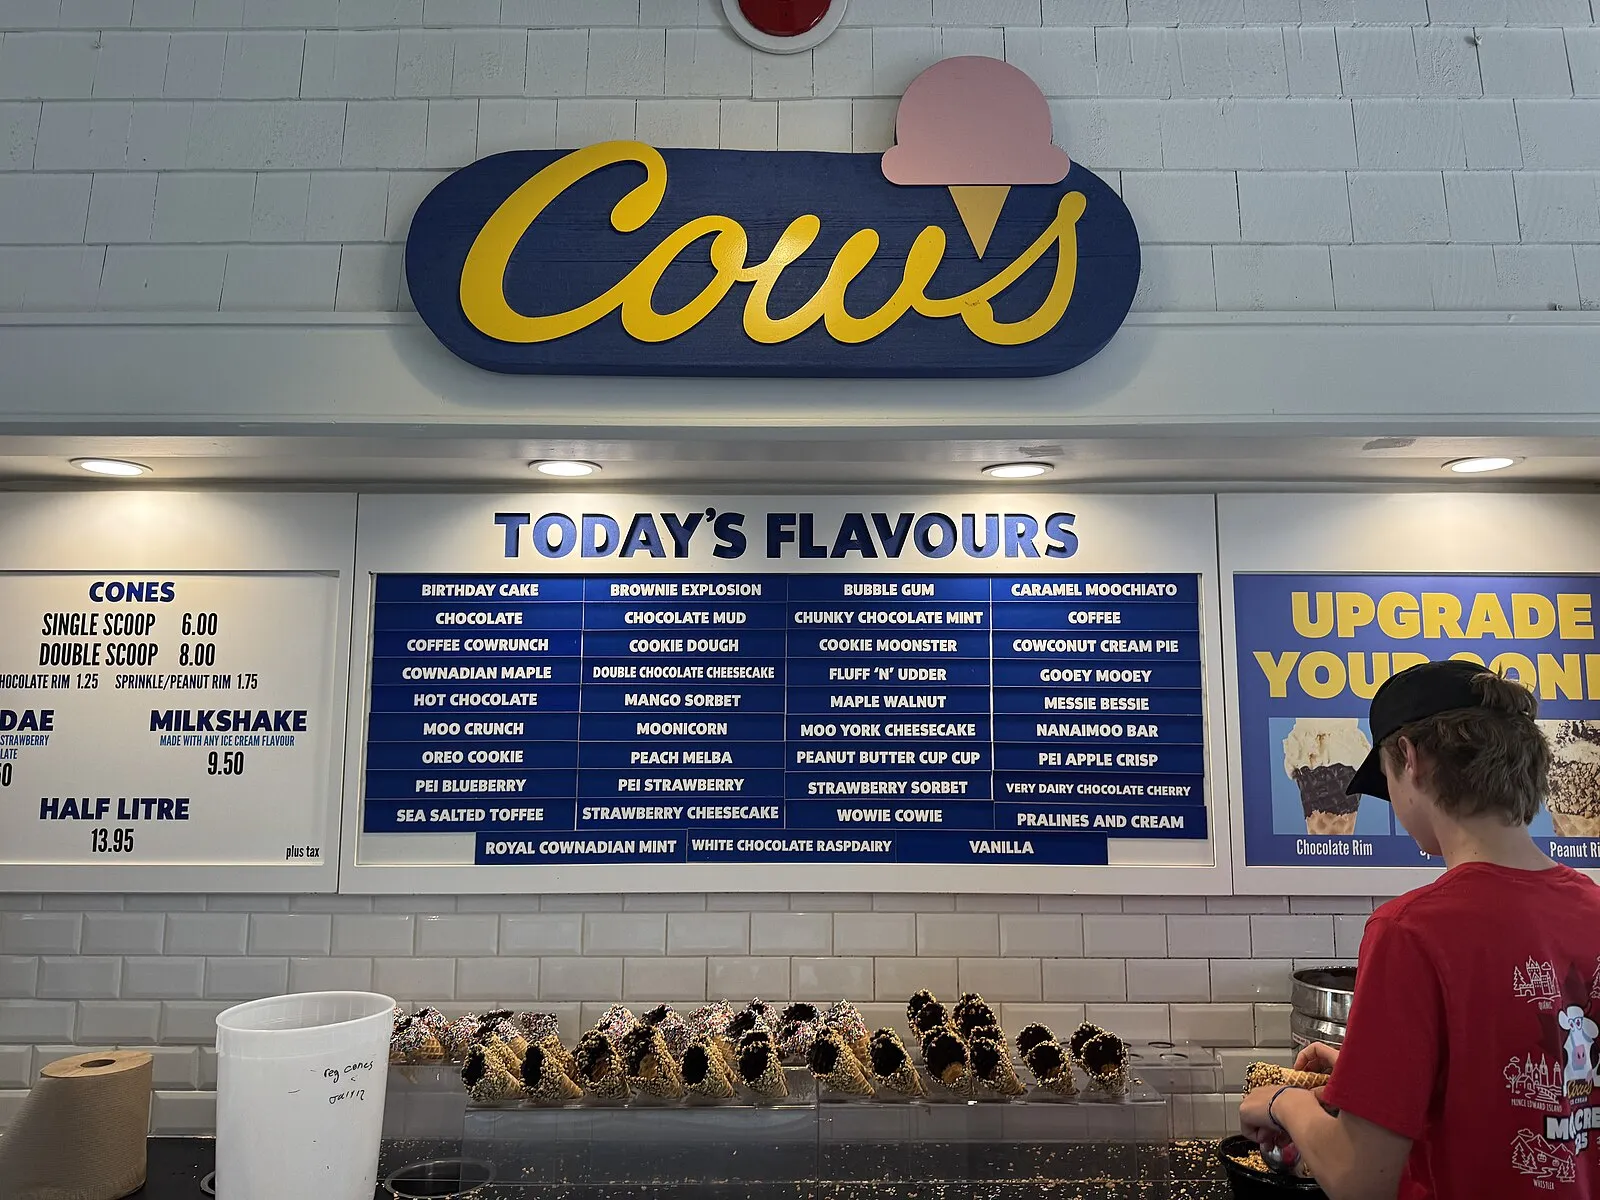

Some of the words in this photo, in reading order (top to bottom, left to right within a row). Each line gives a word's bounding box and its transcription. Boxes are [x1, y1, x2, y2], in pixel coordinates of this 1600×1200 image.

[494, 507, 746, 558] TODAY'S
[766, 511, 1078, 558] FLAVOURS
[89, 581, 175, 602] CONES
[421, 583, 497, 597] BIRTHDAY
[498, 583, 539, 597] CAKE
[610, 583, 679, 597] BROWNIE
[681, 583, 762, 596] EXPLOSION
[843, 583, 898, 596] BUBBLE
[901, 583, 935, 597] GUM
[1010, 583, 1083, 597] CARAMEL
[1085, 583, 1178, 597] MOOCHIATO
[435, 611, 523, 625] CHOCOLATE
[624, 611, 710, 625] CHOCOLATE
[712, 611, 747, 624] MUD
[794, 611, 855, 624] CHUNKY
[857, 611, 943, 624] CHOCOLATE
[946, 611, 984, 625] MINT
[1067, 611, 1122, 625] COFFEE
[1291, 591, 1595, 640] UPGRADE
[41, 612, 99, 636] SINGLE
[102, 612, 156, 636] SCOOP
[181, 612, 218, 636] 6.00
[406, 638, 461, 652] COFFEE
[463, 638, 549, 652] COWRUNCH
[628, 638, 684, 653] COOKIE
[686, 638, 739, 653] DOUGH
[818, 638, 873, 652] COOKIE
[876, 638, 958, 652] MOONSTER
[1012, 638, 1097, 653] COWCONUT
[1100, 639, 1153, 653] CREAM
[1155, 639, 1179, 653] PIE
[38, 643, 101, 666] DOUBLE
[105, 643, 159, 666] SCOOP
[179, 643, 216, 667] 8.00
[402, 666, 498, 680] COWNADIAN
[500, 666, 552, 680] MAPLE
[592, 666, 637, 679] DOUBLE
[638, 666, 704, 679] CHOCOLATE
[706, 666, 775, 679] CHEESECAKE
[829, 667, 871, 681] FLUFF
[897, 667, 947, 681] UDDER
[1039, 668, 1093, 682] GOOEY
[1095, 669, 1153, 683] MOOEY
[1252, 651, 1430, 700] YOU
[51, 673, 70, 690] RIM
[76, 673, 99, 690] 1.25
[115, 673, 211, 691] SPRINKLE/PEANUT
[212, 673, 231, 690] RIM
[237, 673, 258, 690] 1.75
[413, 693, 447, 707] HOT
[449, 693, 538, 706] CHOCOLATE
[624, 693, 682, 707] MANGO
[684, 693, 742, 707] SORBET
[830, 695, 880, 708] MAPLE
[883, 695, 947, 709] WALNUT
[1044, 696, 1097, 710] MESSIE
[1100, 697, 1150, 711] BESSIE
[149, 709, 308, 732] MILKSHAKE
[423, 722, 461, 736] MOO
[464, 722, 524, 736] CRUNCH
[636, 722, 728, 736] MOONICORN
[800, 723, 837, 737] MOO
[839, 723, 881, 737] YORK
[884, 723, 976, 737] CHEESECAKE
[1036, 723, 1124, 738] NANAIMOO
[1126, 724, 1159, 738] BAR
[0, 735, 49, 746] STRAWBERRY
[160, 734, 181, 747] MADE
[183, 734, 202, 747] WITH
[204, 734, 219, 747] ANY
[221, 734, 233, 747] ICE
[234, 734, 260, 747] CREAM
[262, 734, 295, 747] FLAVOUR
[207, 751, 245, 776] 9.50
[421, 750, 464, 764] OREO
[467, 750, 524, 764] COOKIE
[630, 751, 679, 765] PEACH
[682, 751, 733, 764] MELBA
[796, 750, 856, 764] PEANUT
[859, 750, 916, 764] BUTTER
[918, 751, 948, 765] CUP
[951, 751, 981, 765] CUP
[1038, 752, 1062, 766] PEI
[1064, 752, 1113, 767] APPLE
[1115, 753, 1159, 767] CRISP
[415, 779, 439, 793] PEI
[441, 778, 527, 793] BLUEBERRY
[618, 778, 641, 792] PEI
[643, 778, 745, 792] STRAWBERRY
[807, 781, 908, 795] STRAWBERRY
[910, 780, 969, 795] SORBET
[1005, 782, 1037, 794] VERY
[1038, 783, 1075, 794] DAIRY
[1076, 783, 1145, 796] CHOCOLATE
[1146, 785, 1192, 797] CHERRY
[39, 797, 110, 820] HALF
[116, 797, 190, 820] LITRE
[396, 809, 427, 823] SEA
[429, 808, 486, 822] SALTED
[489, 807, 544, 822] TOFFEE
[582, 806, 684, 820] STRAWBERRY
[686, 806, 779, 820] CHEESECAKE
[836, 808, 891, 822] WOWIE
[894, 809, 943, 823] COWIE
[1016, 812, 1090, 828] PRALINES
[1092, 814, 1127, 828] AND
[1130, 815, 1184, 829] CREAM
[91, 828, 135, 853] 13.95
[485, 841, 536, 855] ROYAL
[538, 840, 636, 855] COWNADIAN
[638, 839, 677, 854] MINT
[691, 838, 734, 851] WHITE
[736, 839, 814, 852] CHOCOLATE
[816, 839, 893, 852] RASPDAIRY
[968, 840, 1035, 854] VANILLA
[1296, 839, 1350, 855] Chocolate
[1352, 840, 1373, 856] Rim
[286, 845, 304, 860] plus
[306, 846, 320, 858] tax
[1550, 841, 1590, 858] Peanut
[1546, 1103, 1563, 1113] ISLAND
